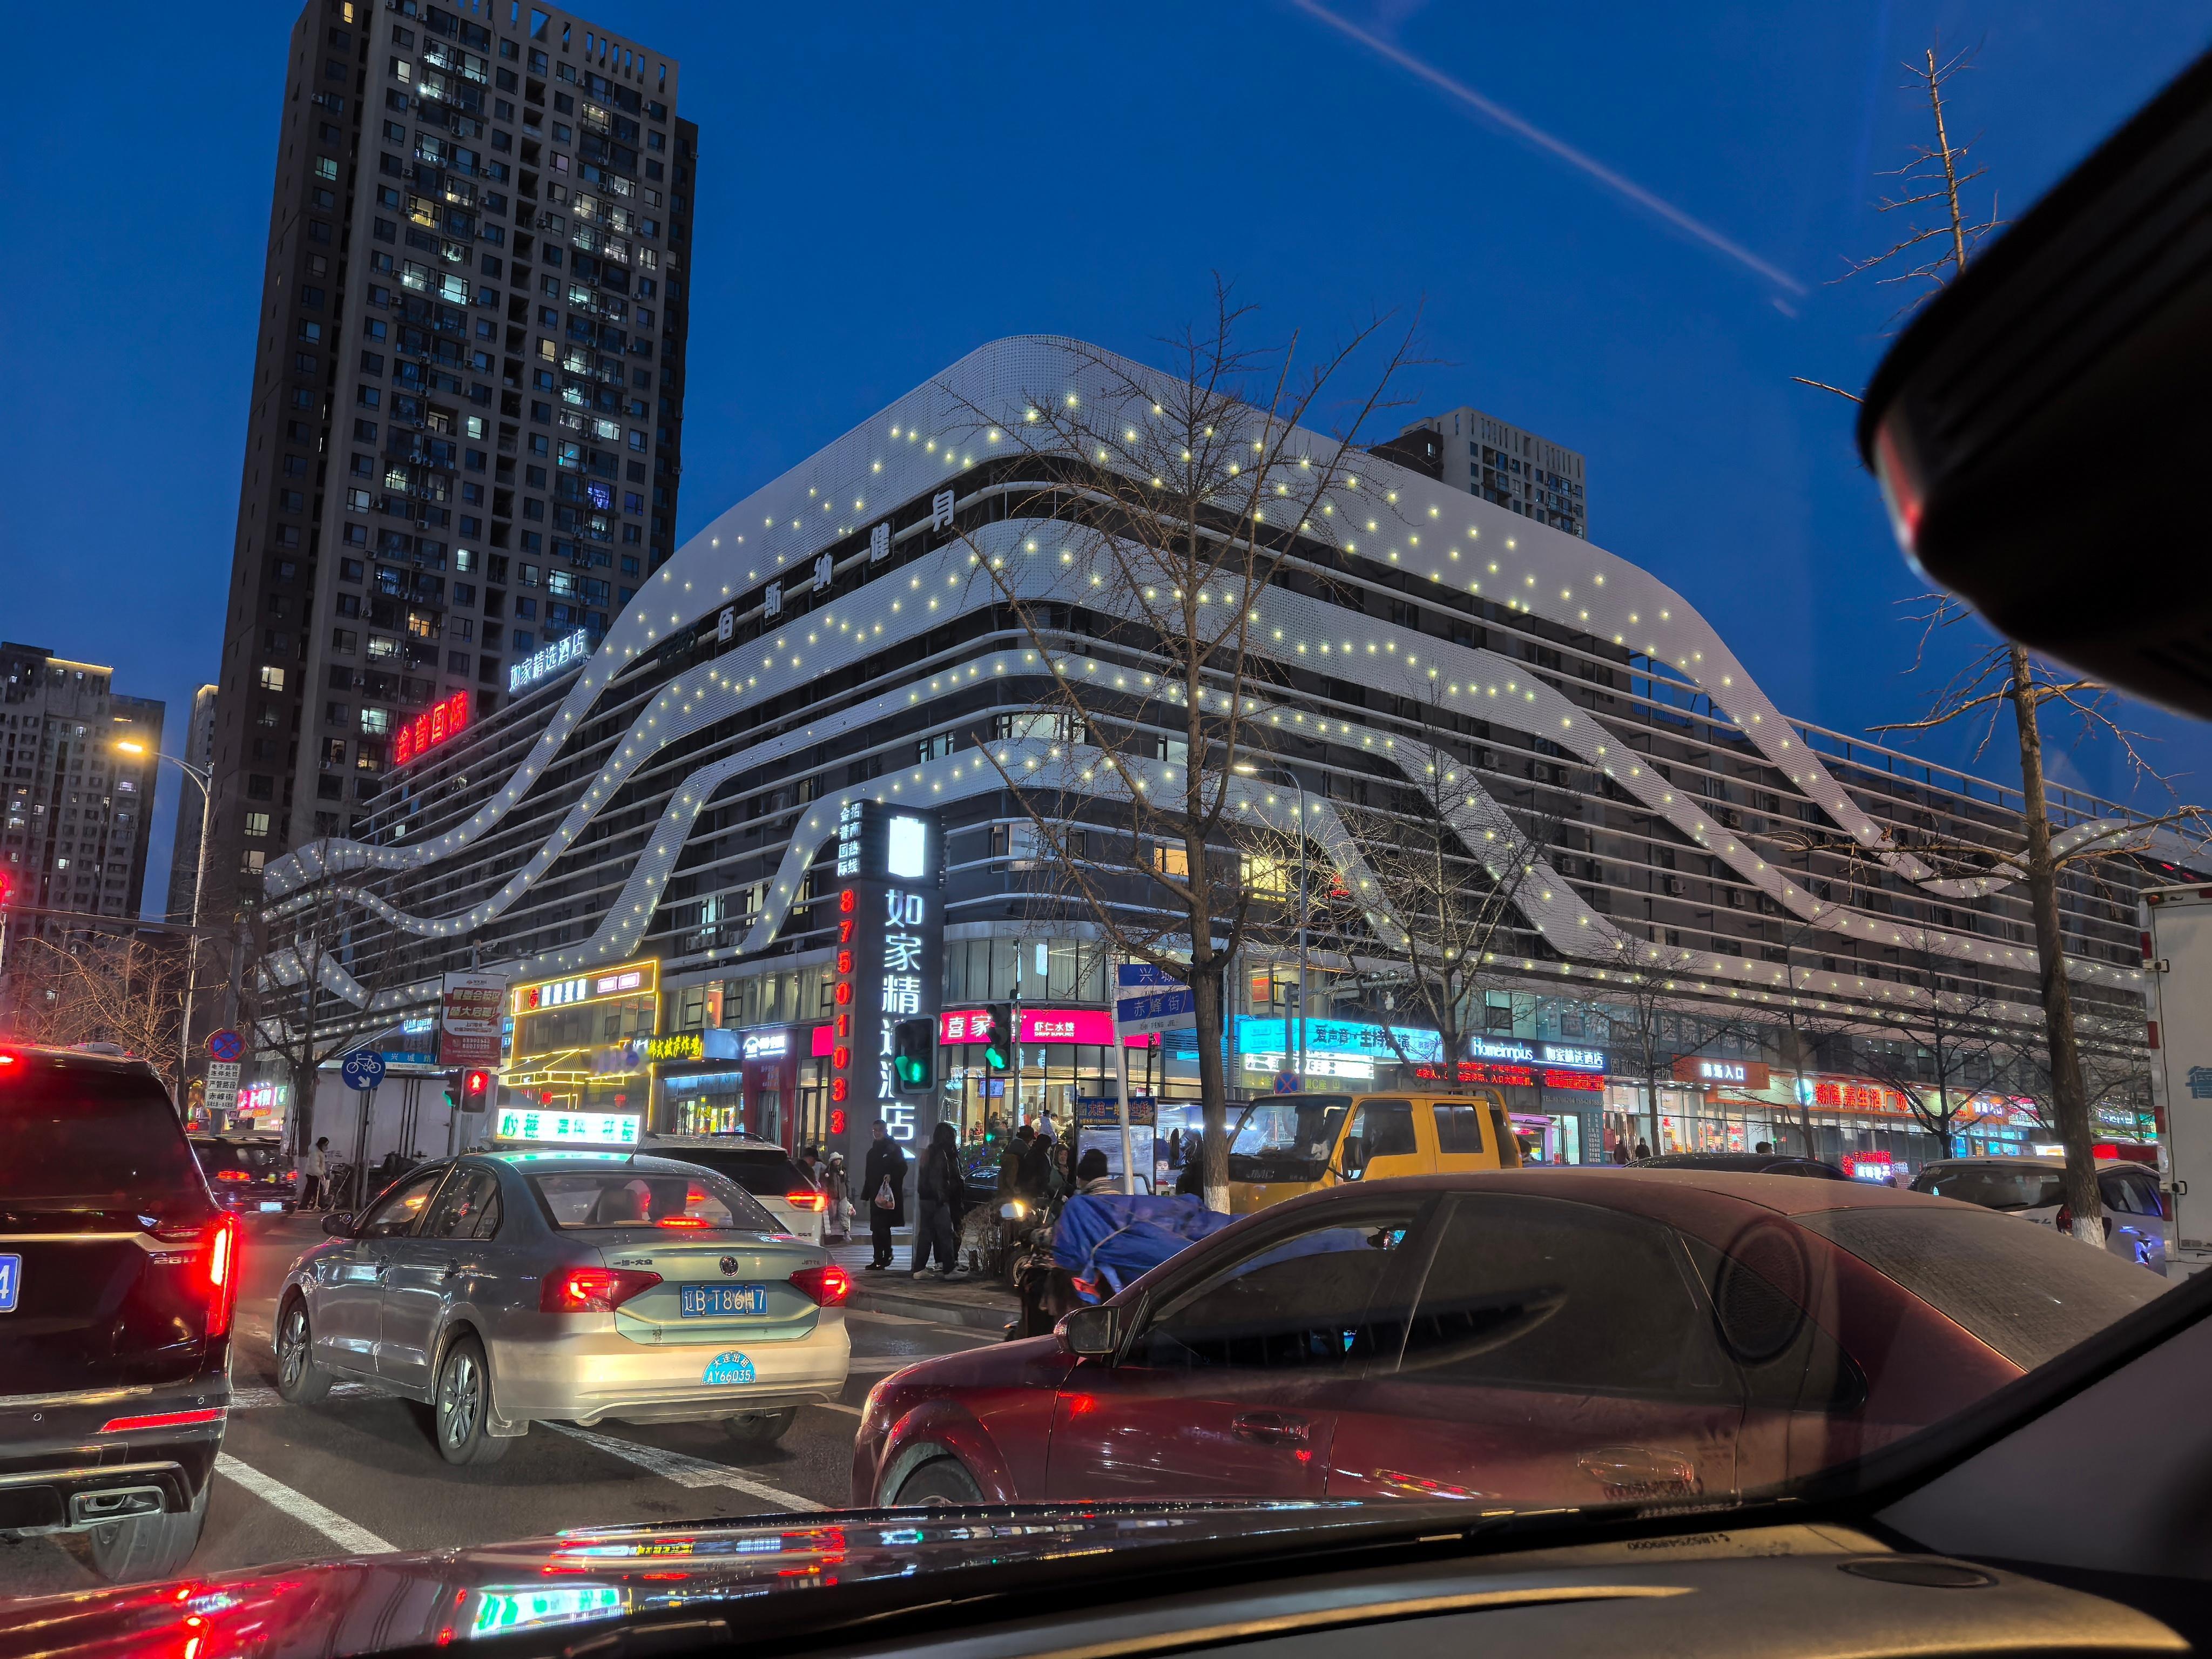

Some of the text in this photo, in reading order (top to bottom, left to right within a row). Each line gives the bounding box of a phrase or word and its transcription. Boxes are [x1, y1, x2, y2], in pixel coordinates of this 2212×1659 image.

[509, 629, 585, 692] 如家精选酒店
[831, 889, 854, 1134] 87501033
[1134, 995, 1180, 1017] 赤峰街
[208, 1092, 234, 1101] 赤峰街
[713, 1353, 750, 1368] 大连出租
